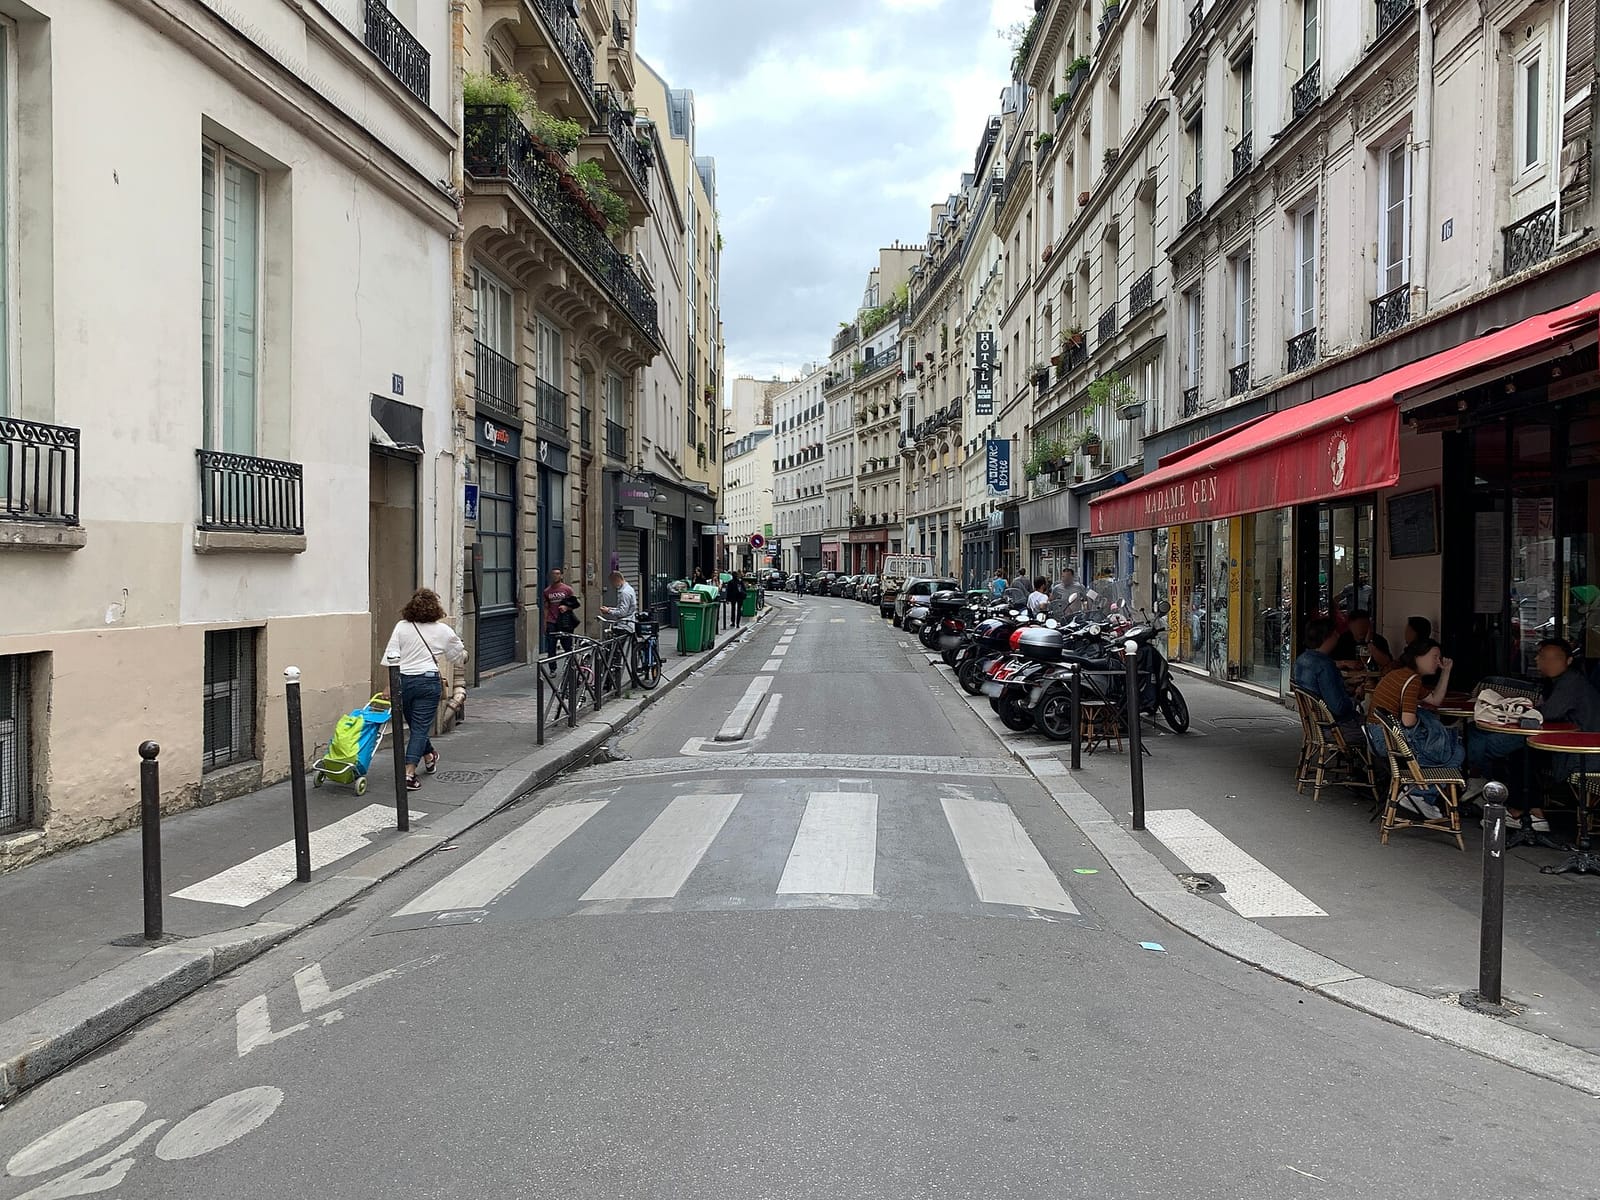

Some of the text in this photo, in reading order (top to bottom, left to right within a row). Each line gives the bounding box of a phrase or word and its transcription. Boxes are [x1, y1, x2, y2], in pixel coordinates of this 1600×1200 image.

[1444, 221, 1451, 239] 16
[394, 375, 402, 392] 15
[1145, 476, 1217, 514] MADAME GEN
